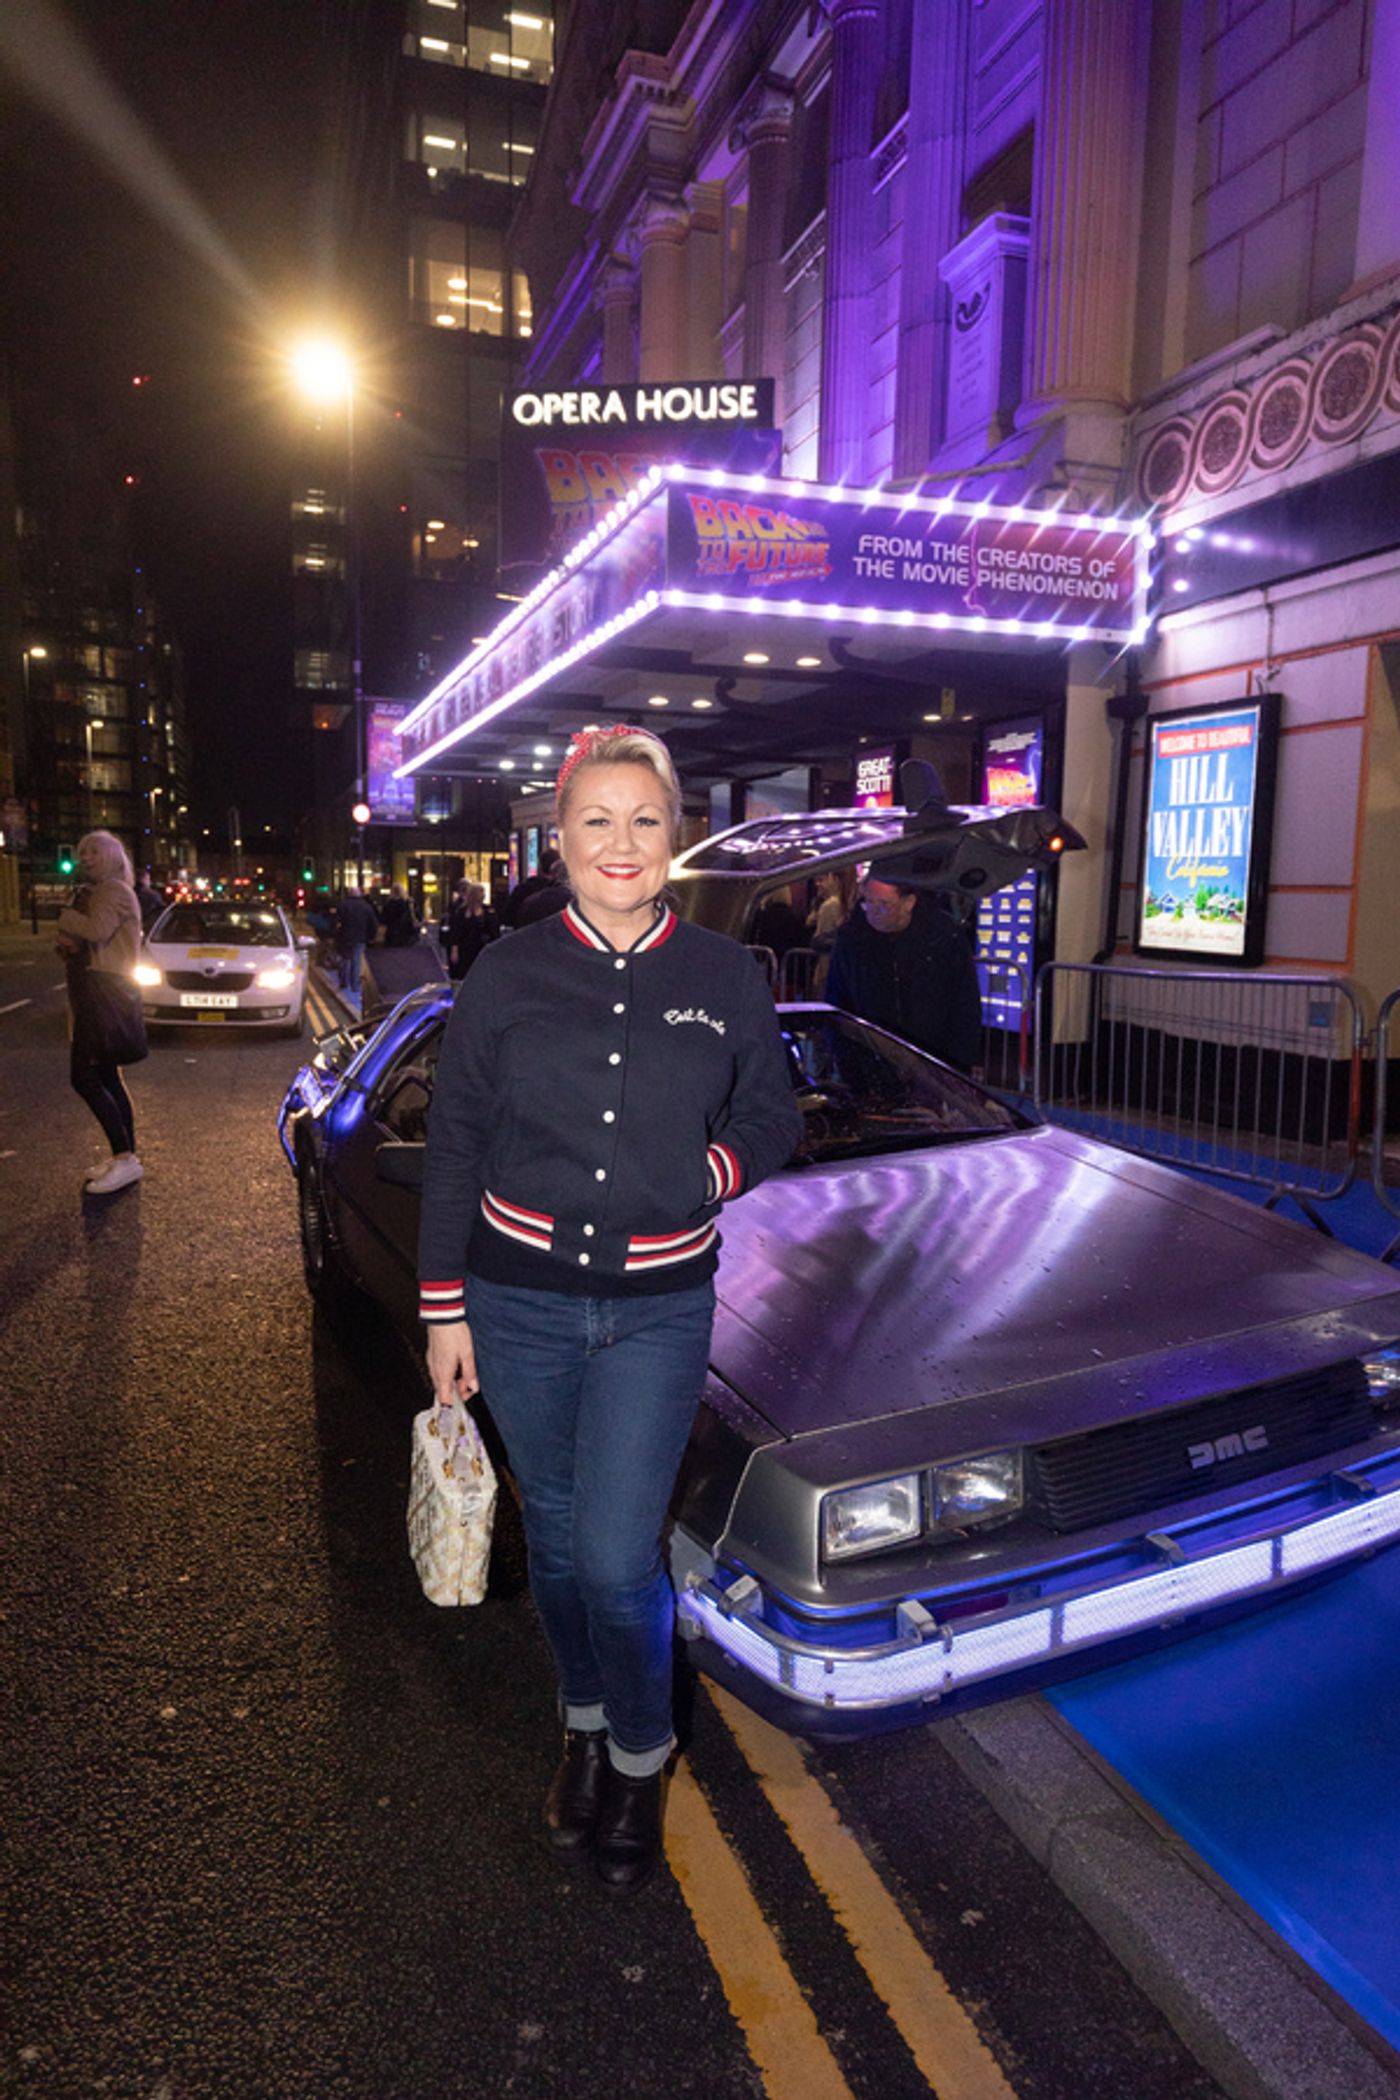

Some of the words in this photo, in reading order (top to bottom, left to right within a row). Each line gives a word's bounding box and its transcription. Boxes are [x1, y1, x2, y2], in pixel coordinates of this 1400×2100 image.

[512, 390, 627, 426] OPERA
[636, 384, 758, 421] HOUSE
[687, 493, 810, 540] BACK
[727, 540, 831, 575] FUTURE
[853, 556, 895, 579] THE
[902, 561, 970, 587] MOVIE
[976, 569, 1119, 600] PHENOMENON
[858, 534, 923, 559] FROM
[929, 541, 970, 564] THE
[976, 547, 1082, 576] CREATORS
[1088, 559, 1116, 578] OF
[1197, 732, 1207, 748] TO
[857, 756, 891, 778] GREAT
[1169, 752, 1234, 806] HILL
[1153, 806, 1249, 858] VALLEY
[1187, 1425, 1269, 1470] DMC
